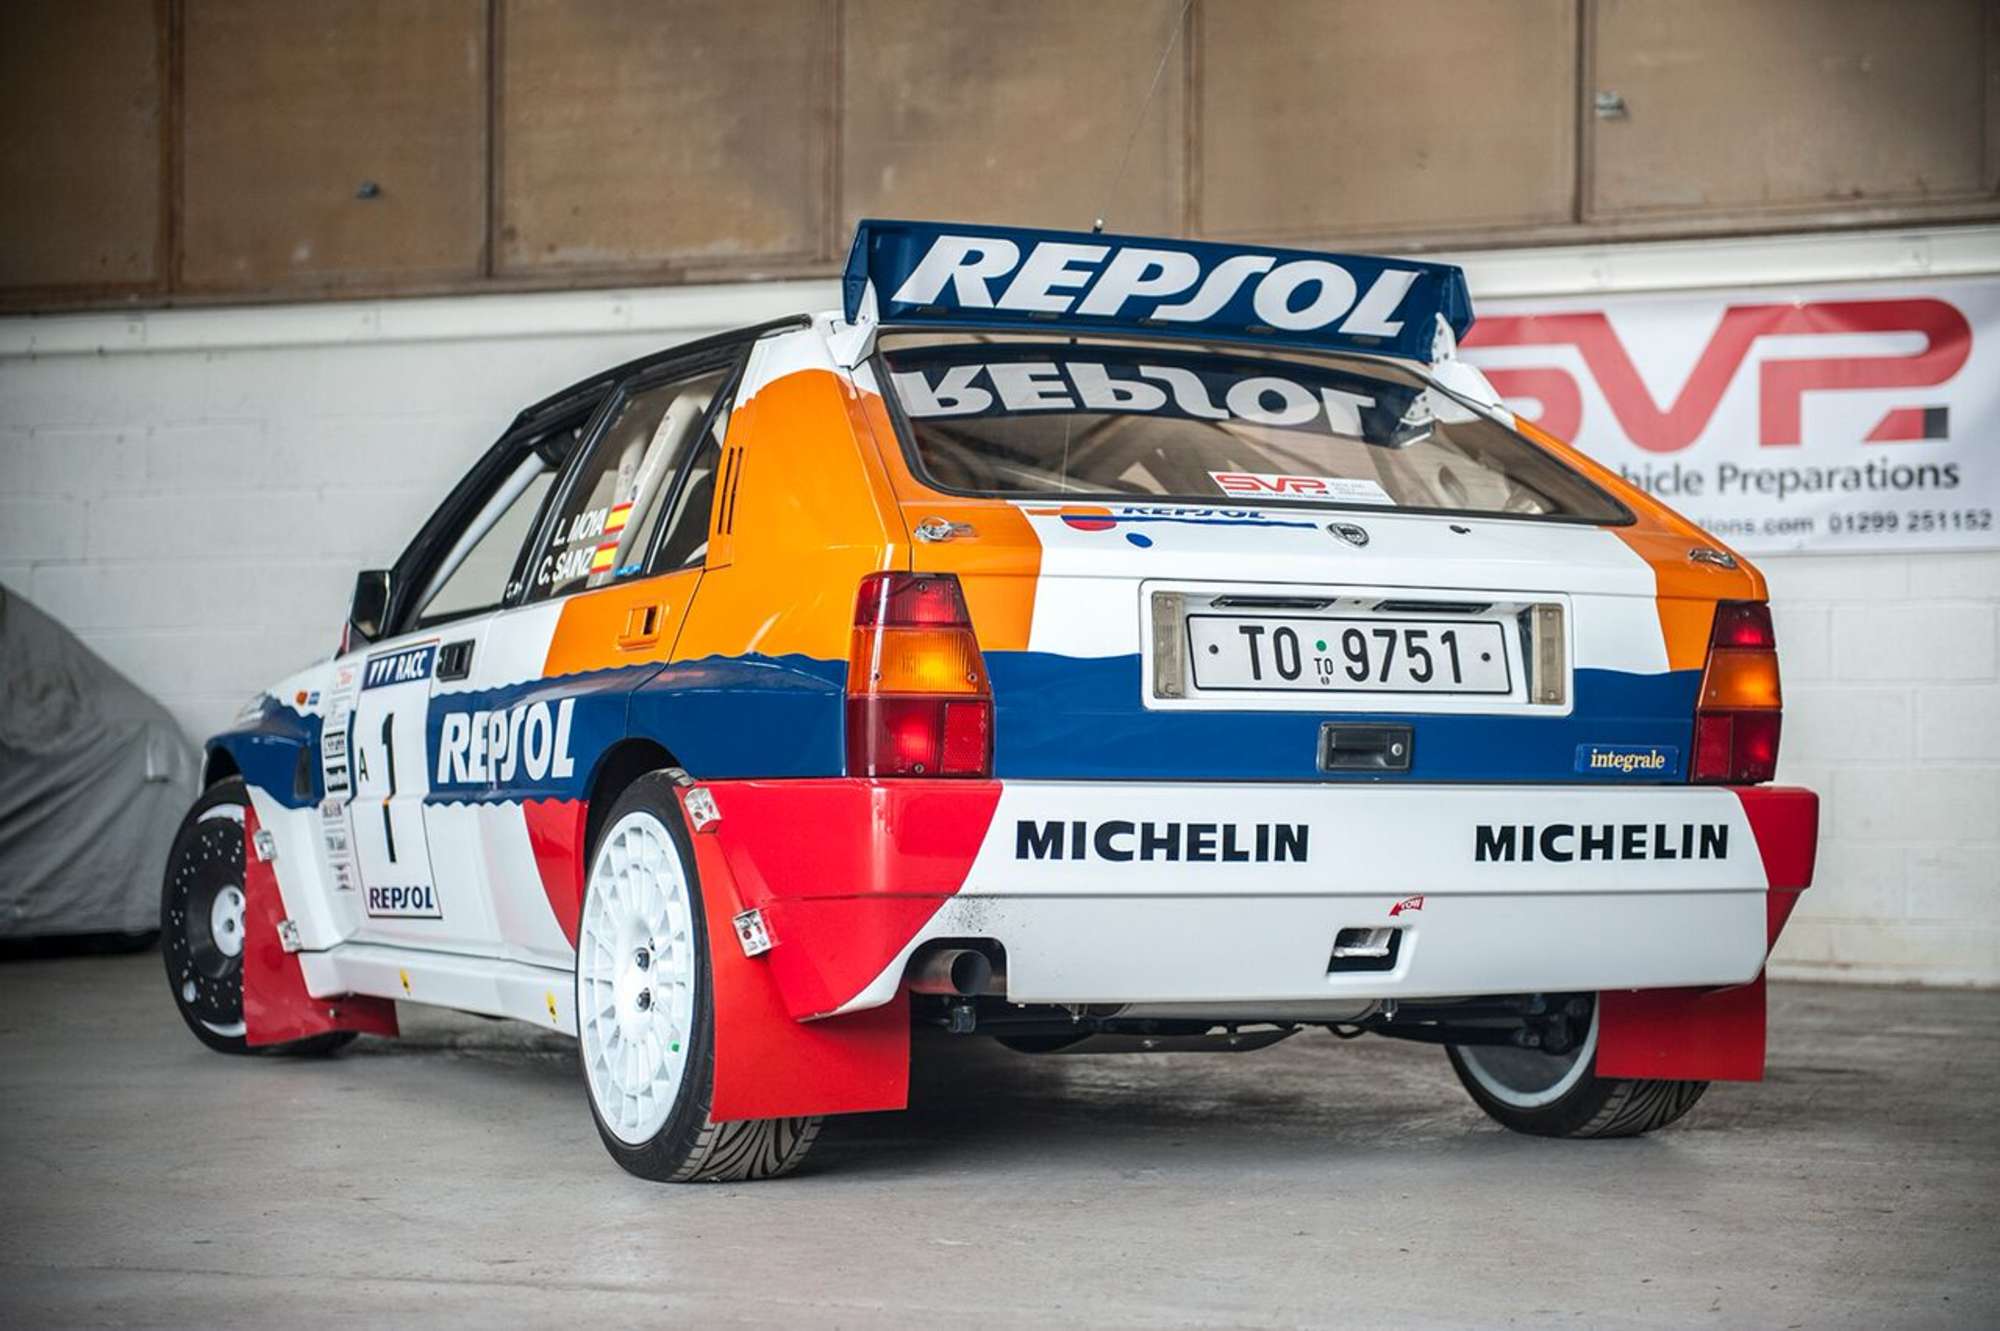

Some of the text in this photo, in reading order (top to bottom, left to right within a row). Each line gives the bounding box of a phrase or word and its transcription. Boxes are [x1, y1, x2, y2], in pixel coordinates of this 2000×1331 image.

[892, 235, 1420, 337] REPSOL
[1216, 474, 1327, 494] SVP
[1718, 454, 1961, 498] Preparations
[567, 507, 609, 544] MOYA
[1829, 513, 1899, 534] 01299
[1907, 509, 1993, 533] 251152
[552, 546, 597, 582] SANZ
[1239, 625, 1463, 684] TO 9751
[437, 699, 577, 783] REPSOL
[359, 747, 369, 782] A
[1590, 748, 1665, 772] integrale
[1015, 820, 1309, 862] MICHELIN
[1474, 824, 1729, 862] MICHELIN
[369, 886, 434, 909] REPSOL
